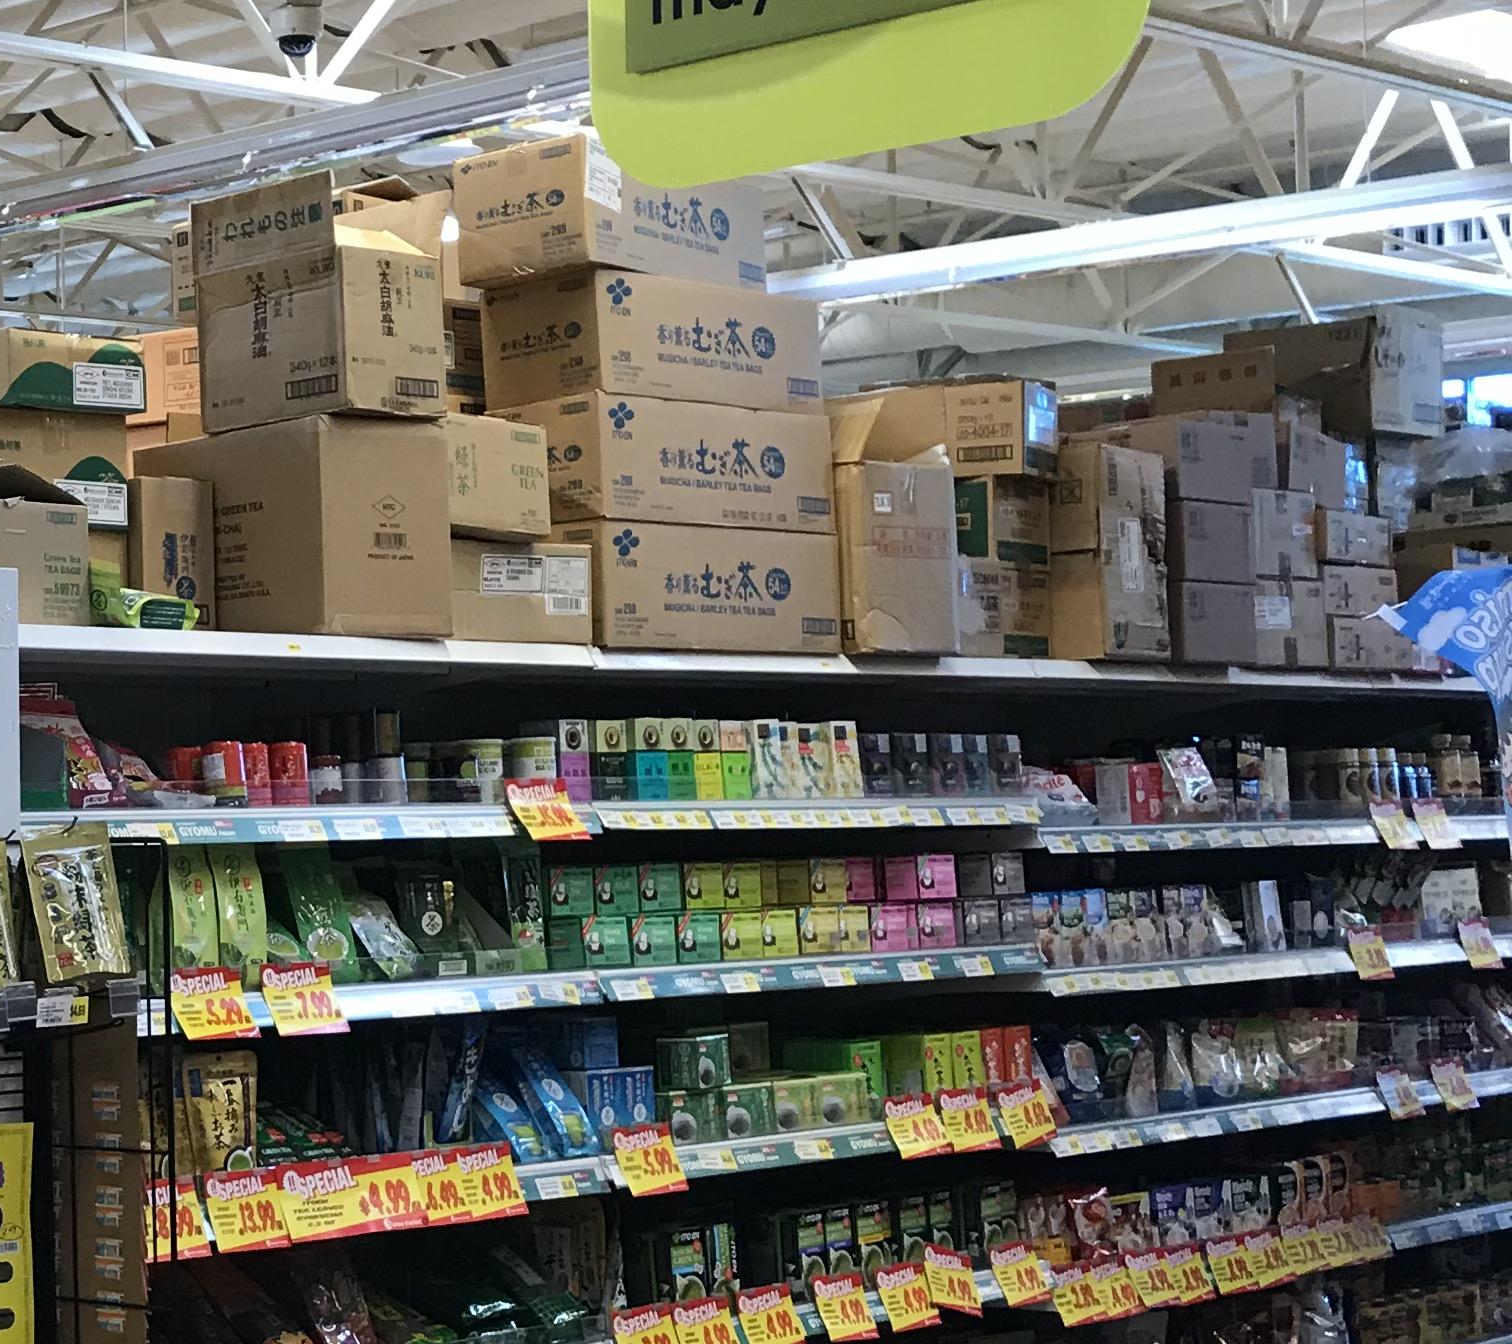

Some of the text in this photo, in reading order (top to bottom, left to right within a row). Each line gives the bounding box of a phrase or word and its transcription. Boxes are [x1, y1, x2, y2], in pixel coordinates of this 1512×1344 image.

[512, 464, 544, 478] GREEN
[520, 477, 537, 490] TEA
[517, 783, 557, 806] SPECIAL
[179, 823, 217, 839] GYOMU
[182, 972, 229, 997] SPECIAL
[275, 967, 321, 991] SPECIAL
[623, 1126, 663, 1152] SPECIAL
[412, 1155, 448, 1176] PECIAL
[458, 1148, 503, 1173] SPECIAL
[218, 1175, 266, 1202] SPECIAL
[297, 1165, 357, 1201] SPECIAL
